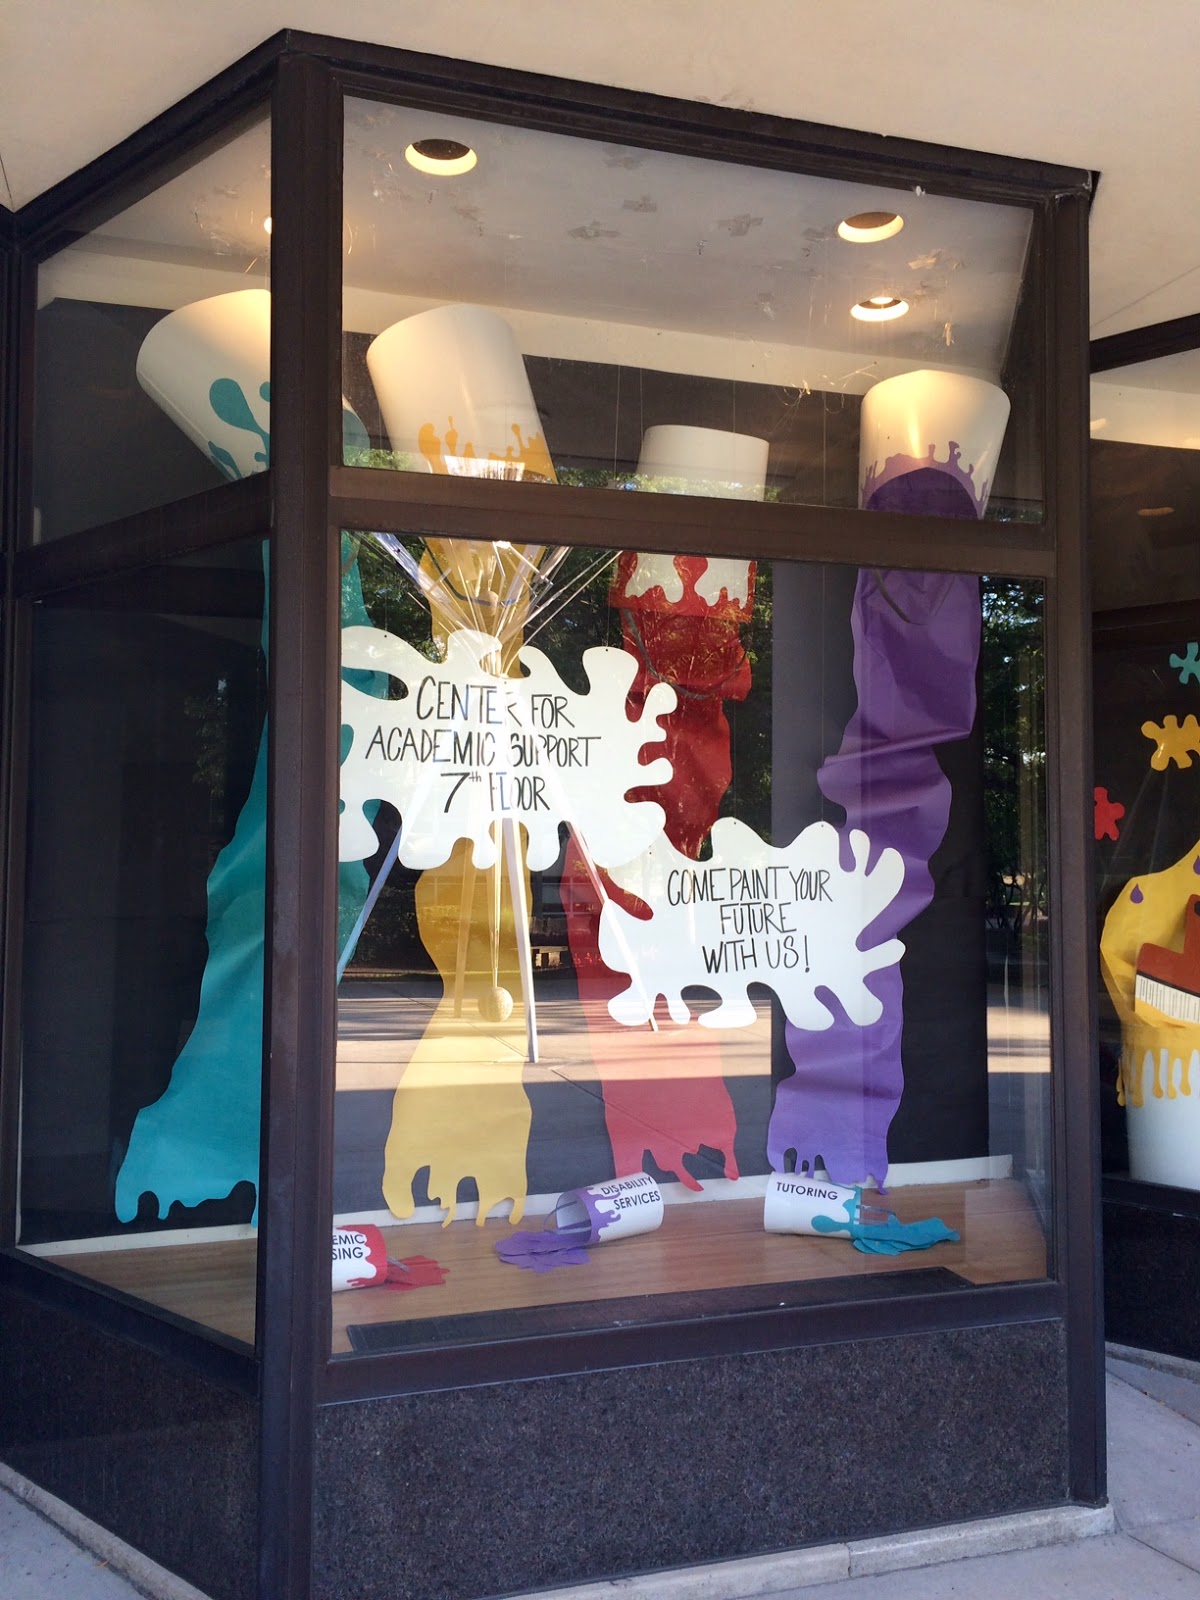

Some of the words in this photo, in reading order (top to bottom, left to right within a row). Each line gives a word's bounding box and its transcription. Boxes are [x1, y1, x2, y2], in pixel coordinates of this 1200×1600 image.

[416, 675, 523, 728] CENTER
[531, 693, 575, 728] FOR
[365, 725, 496, 767] ACADEMIC
[508, 732, 602, 767] SUPPORT
[488, 771, 550, 812] FLOOR
[667, 867, 726, 906] COME
[729, 866, 789, 901] PAINT
[788, 868, 833, 902] YOUR
[720, 901, 797, 935] FUTURE
[702, 937, 757, 974] WITH
[765, 935, 810, 973] US!
[601, 1176, 653, 1195] DISABILITY
[613, 1190, 661, 1210] SERVICES
[776, 1181, 838, 1201] TUTORING
